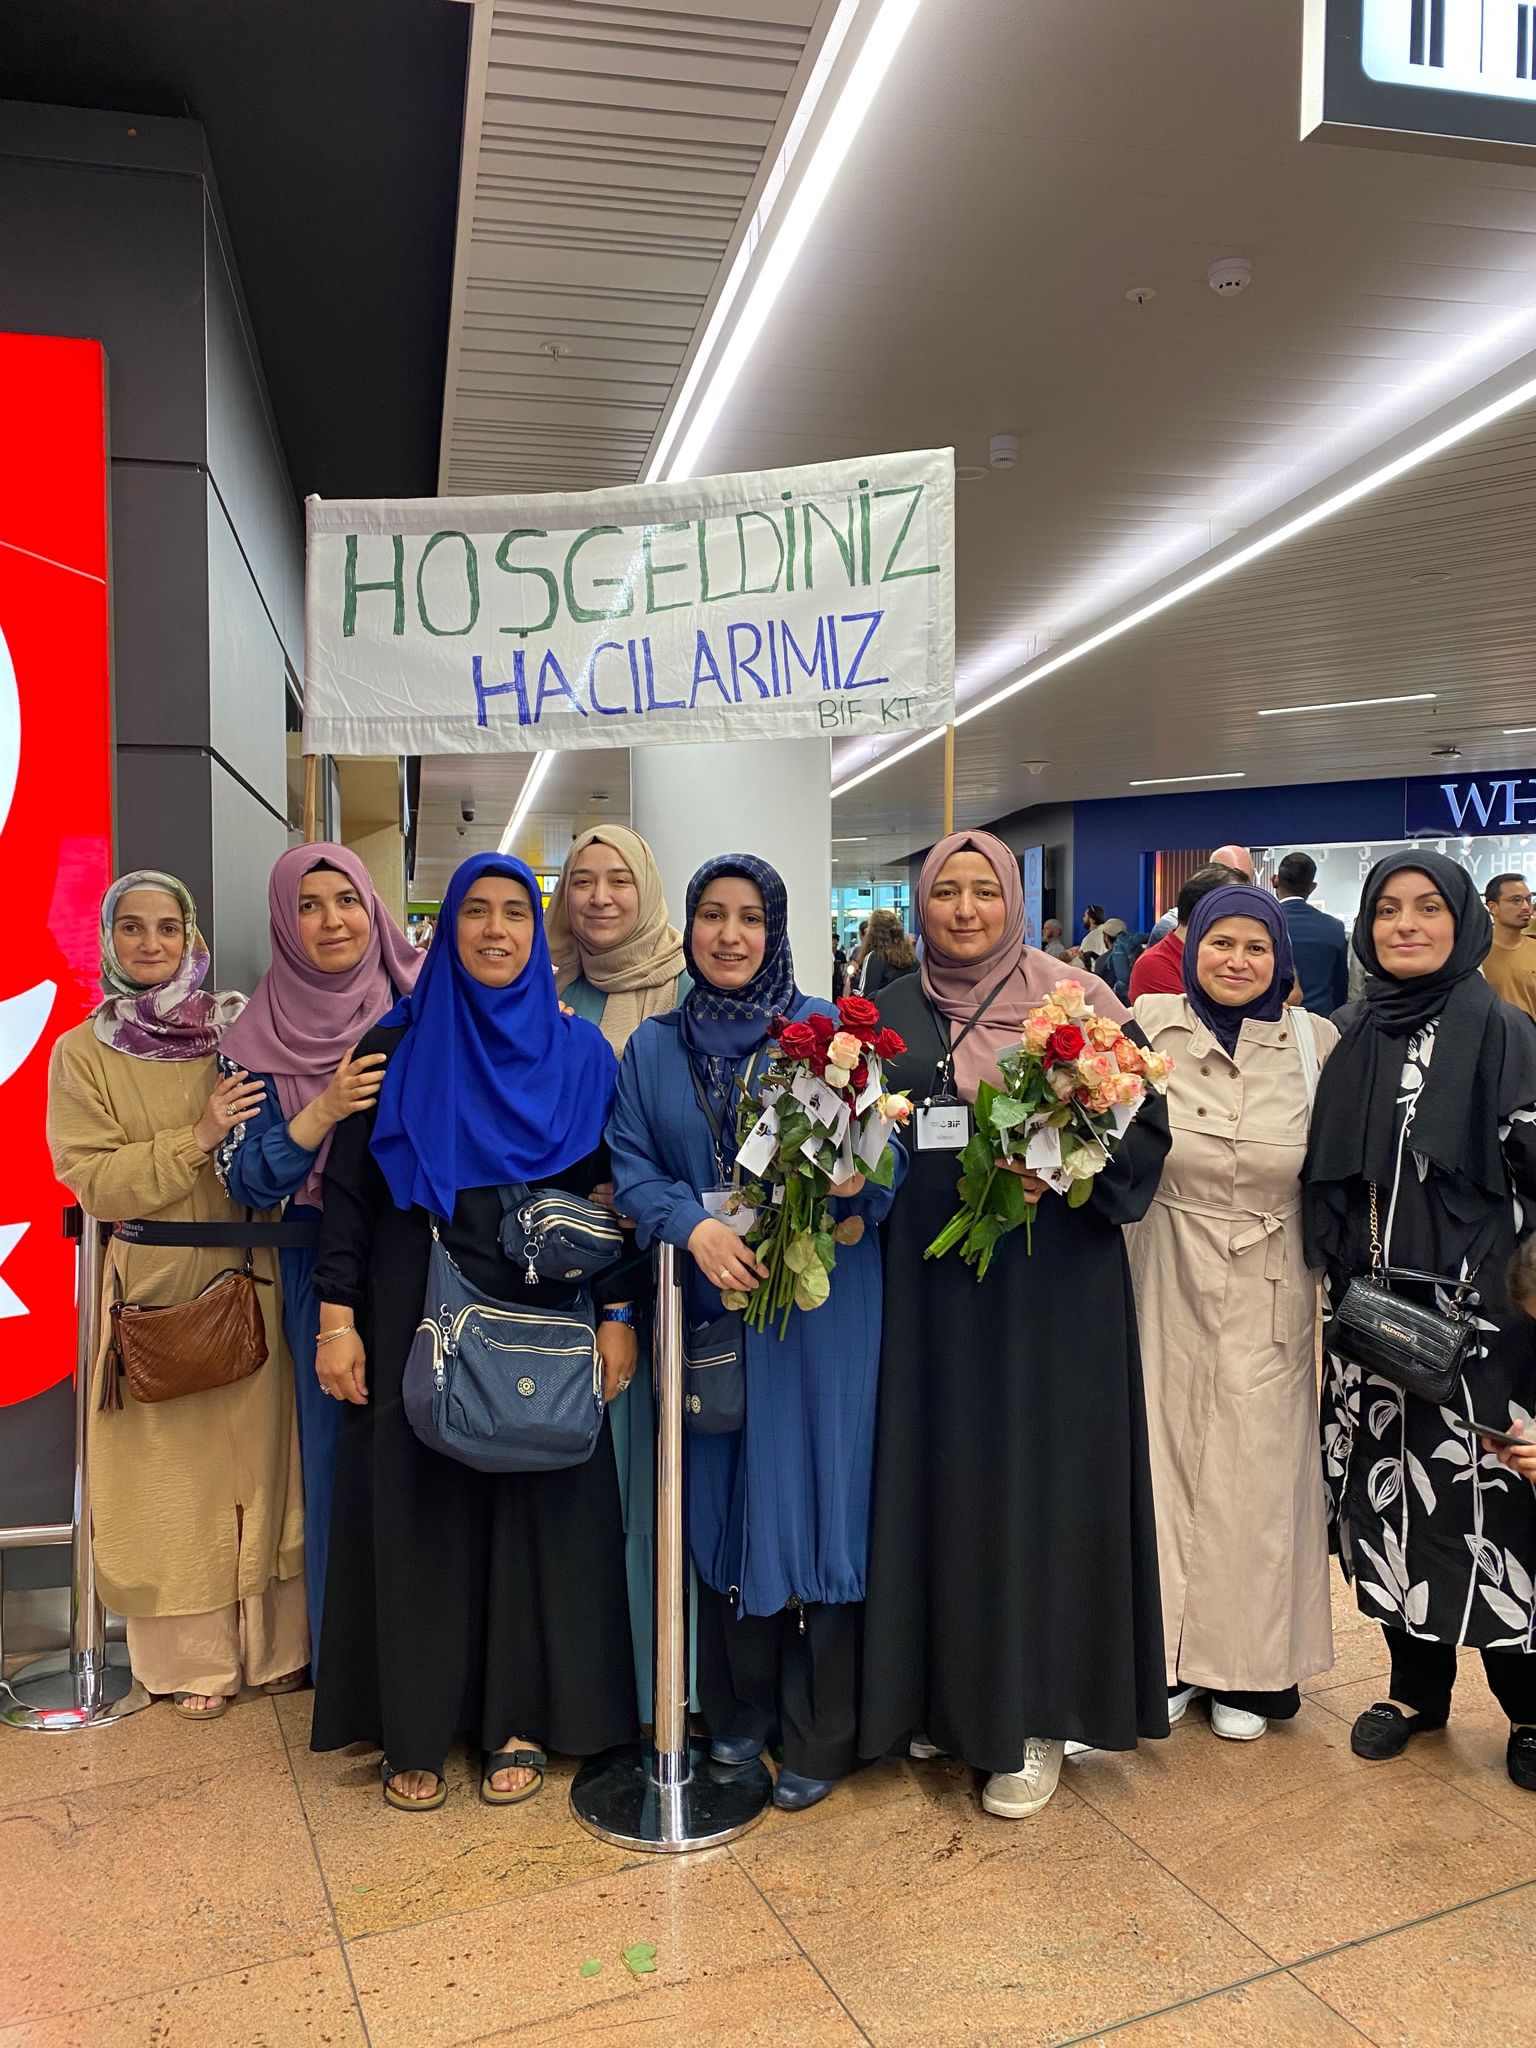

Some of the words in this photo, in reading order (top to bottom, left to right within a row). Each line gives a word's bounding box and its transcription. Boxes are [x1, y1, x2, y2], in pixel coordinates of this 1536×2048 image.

[343, 479, 941, 638] HOŞGELDİNİZ
[472, 609, 889, 727] HACILARIMIZ
[881, 696, 918, 725] KT
